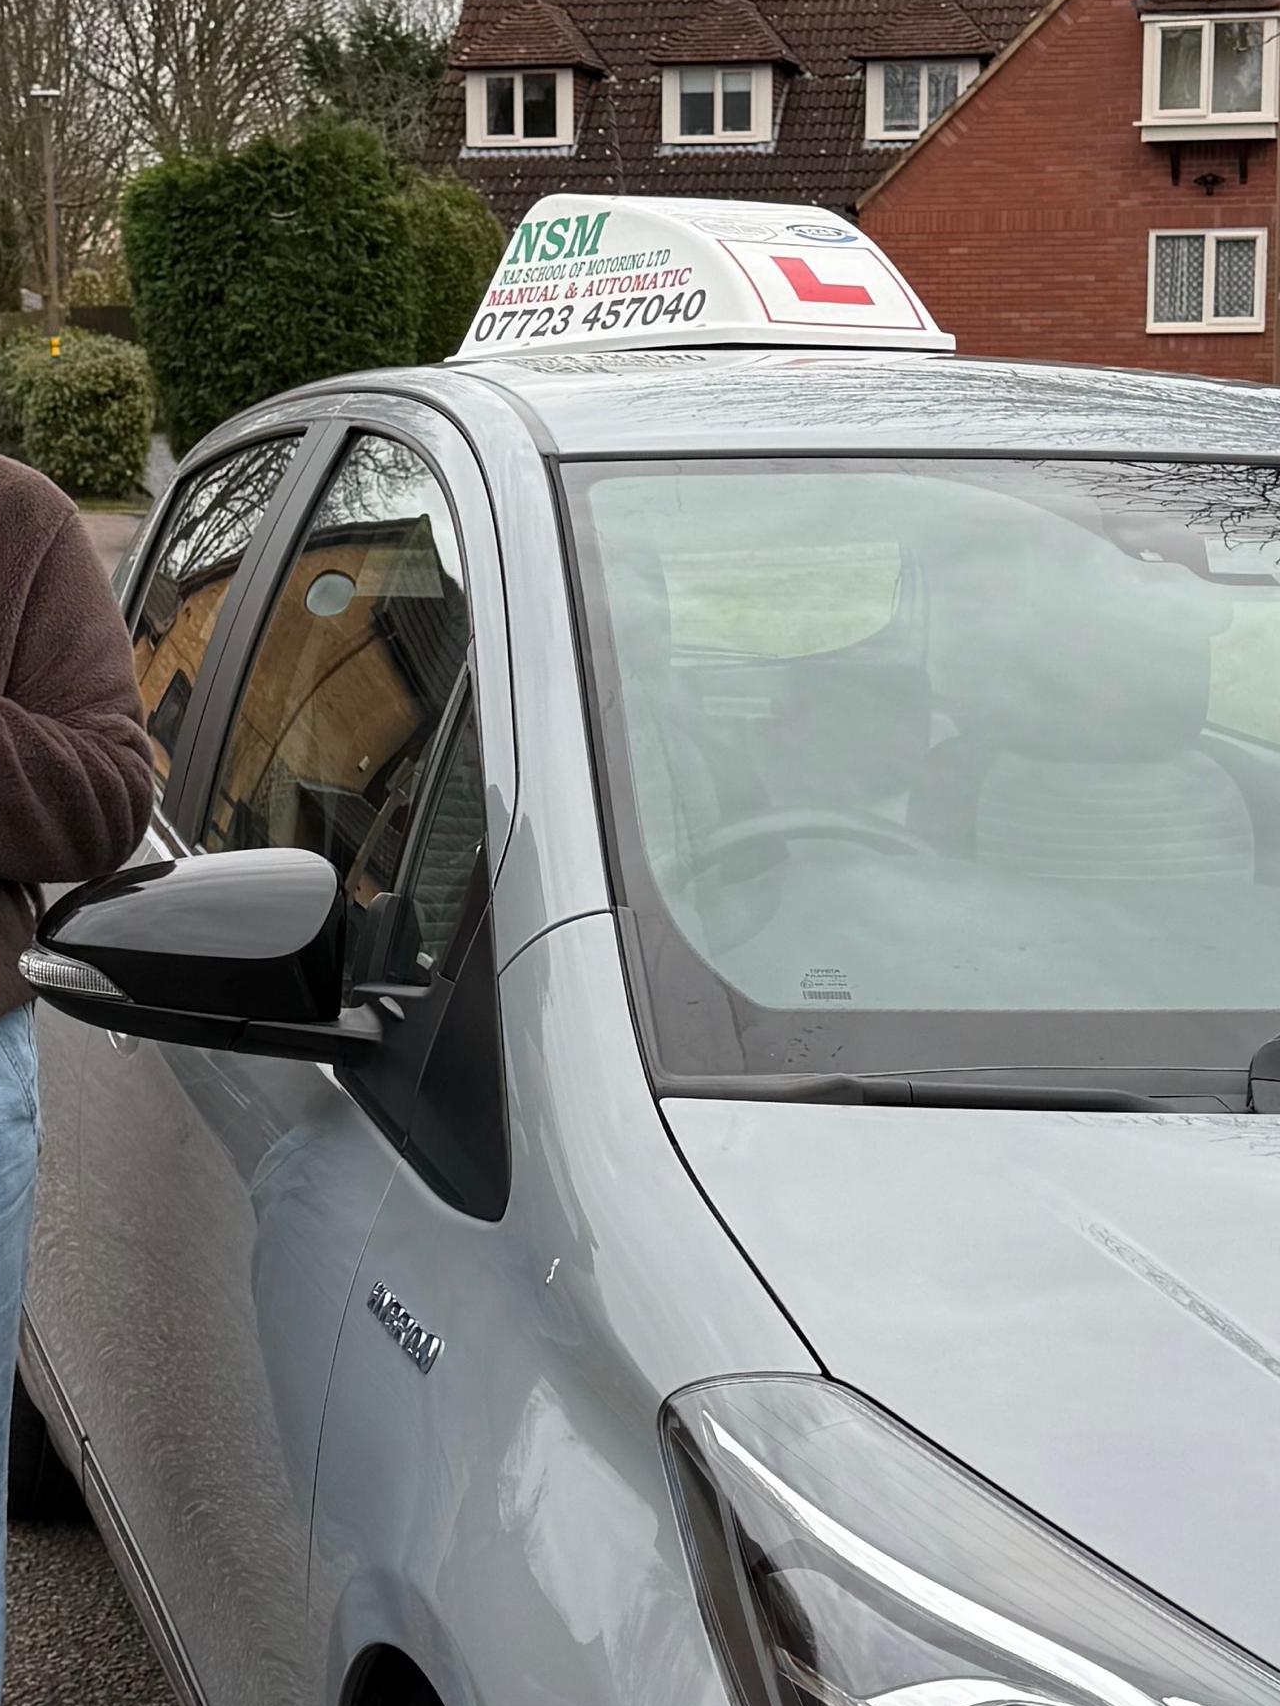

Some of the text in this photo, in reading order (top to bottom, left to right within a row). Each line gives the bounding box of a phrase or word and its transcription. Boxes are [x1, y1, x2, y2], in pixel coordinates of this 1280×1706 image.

[507, 212, 611, 265] NSM
[487, 267, 692, 307] MANUAL & AUTOMATIC
[522, 263, 567, 284] SCHOOL
[569, 262, 584, 279] OF
[585, 252, 646, 277] MOTORING
[646, 248, 671, 269] LTD
[770, 256, 875, 305] L
[475, 290, 706, 342] 07723 457040
